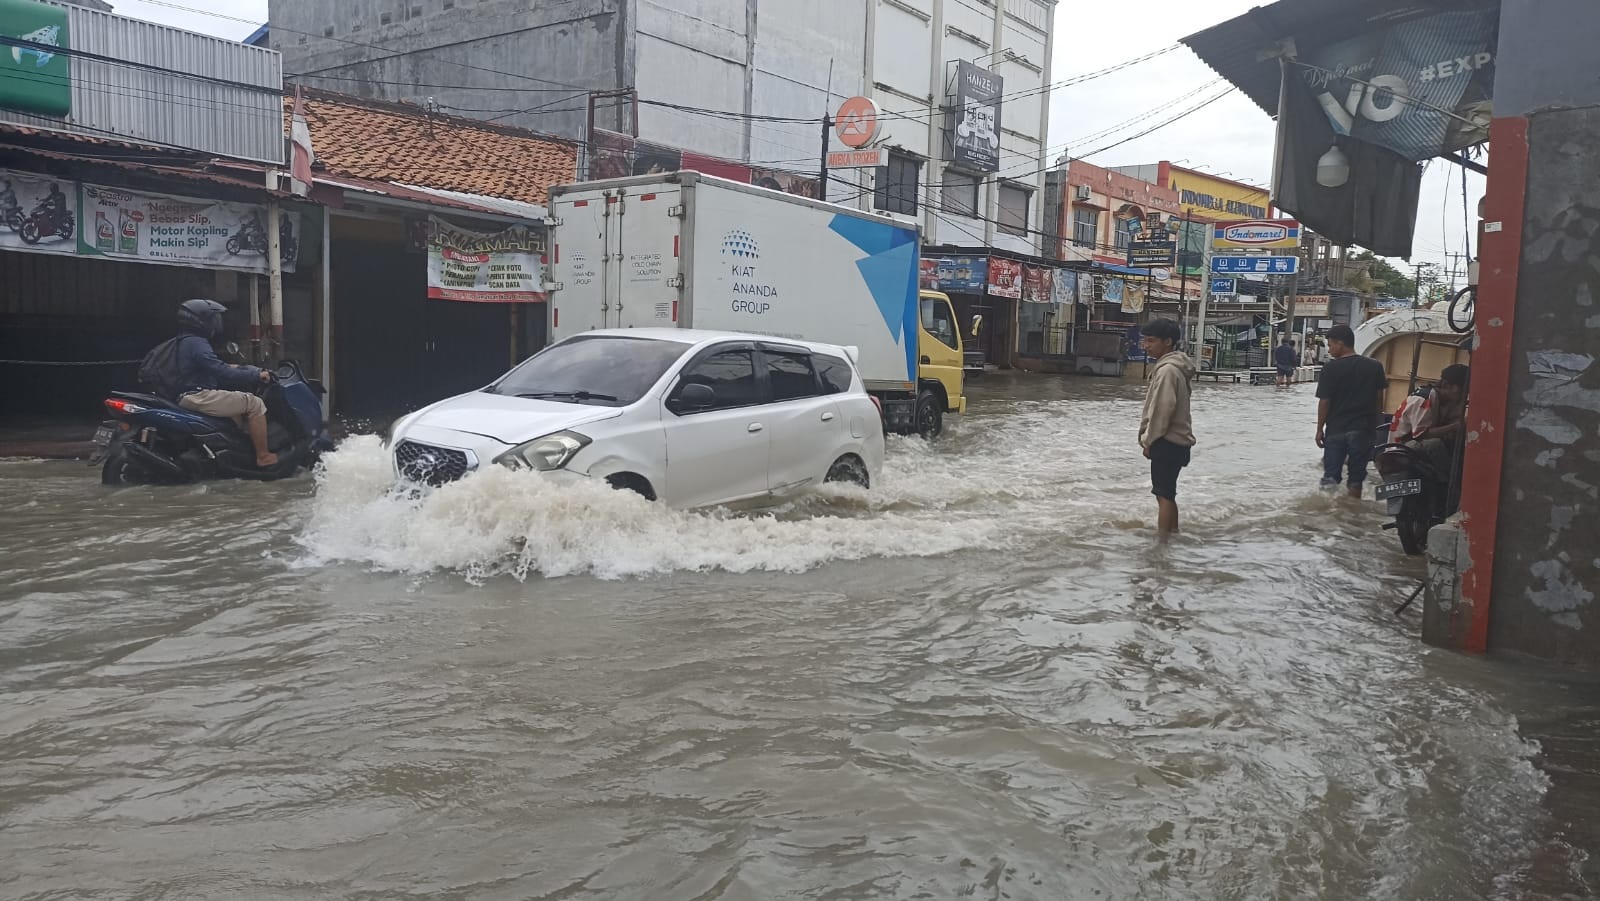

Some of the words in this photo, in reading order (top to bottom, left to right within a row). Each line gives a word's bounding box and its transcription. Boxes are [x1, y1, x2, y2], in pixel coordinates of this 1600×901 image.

[829, 153, 850, 166] ANEKA
[853, 151, 879, 164] FROZEN
[99, 190, 132, 201] Castrol
[98, 199, 118, 207] Activ
[150, 214, 186, 224] Bebas
[188, 213, 211, 225] Slip,
[150, 226, 184, 235] Motor
[187, 226, 228, 237] Kopling
[1229, 229, 1283, 239] Indomaret
[150, 238, 184, 247] Makin
[187, 238, 209, 248] Sip!
[732, 265, 756, 278] KIAT
[732, 282, 778, 298] ANANDA
[732, 300, 770, 314] GROUP
